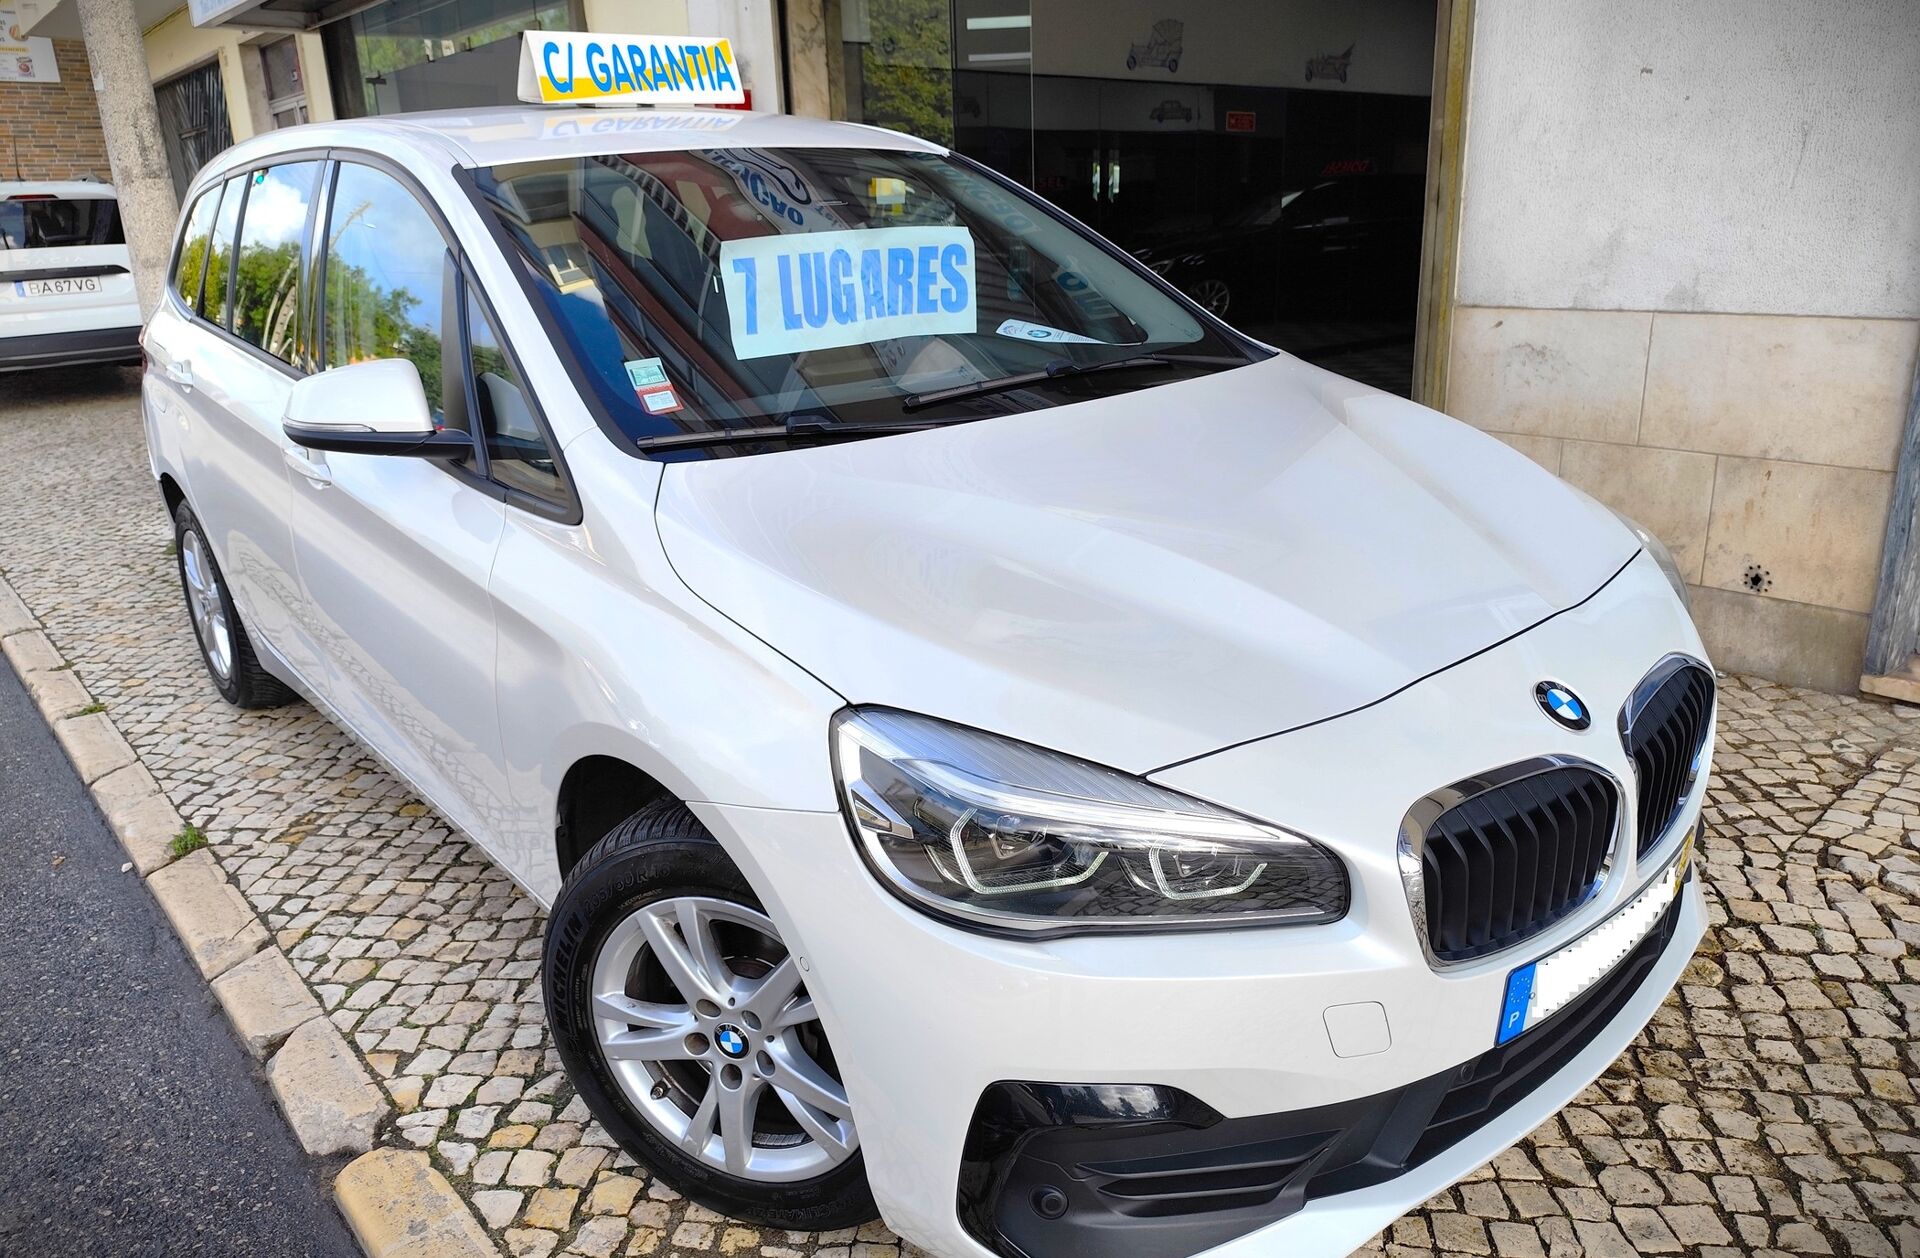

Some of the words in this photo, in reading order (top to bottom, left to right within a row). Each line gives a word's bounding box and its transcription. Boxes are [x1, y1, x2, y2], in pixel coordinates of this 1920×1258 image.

[543, 41, 573, 93] C/
[585, 42, 736, 93] GARANTIA
[732, 257, 758, 335] 7
[777, 243, 968, 330] LUGARES
[1508, 1011, 1520, 1029] P
